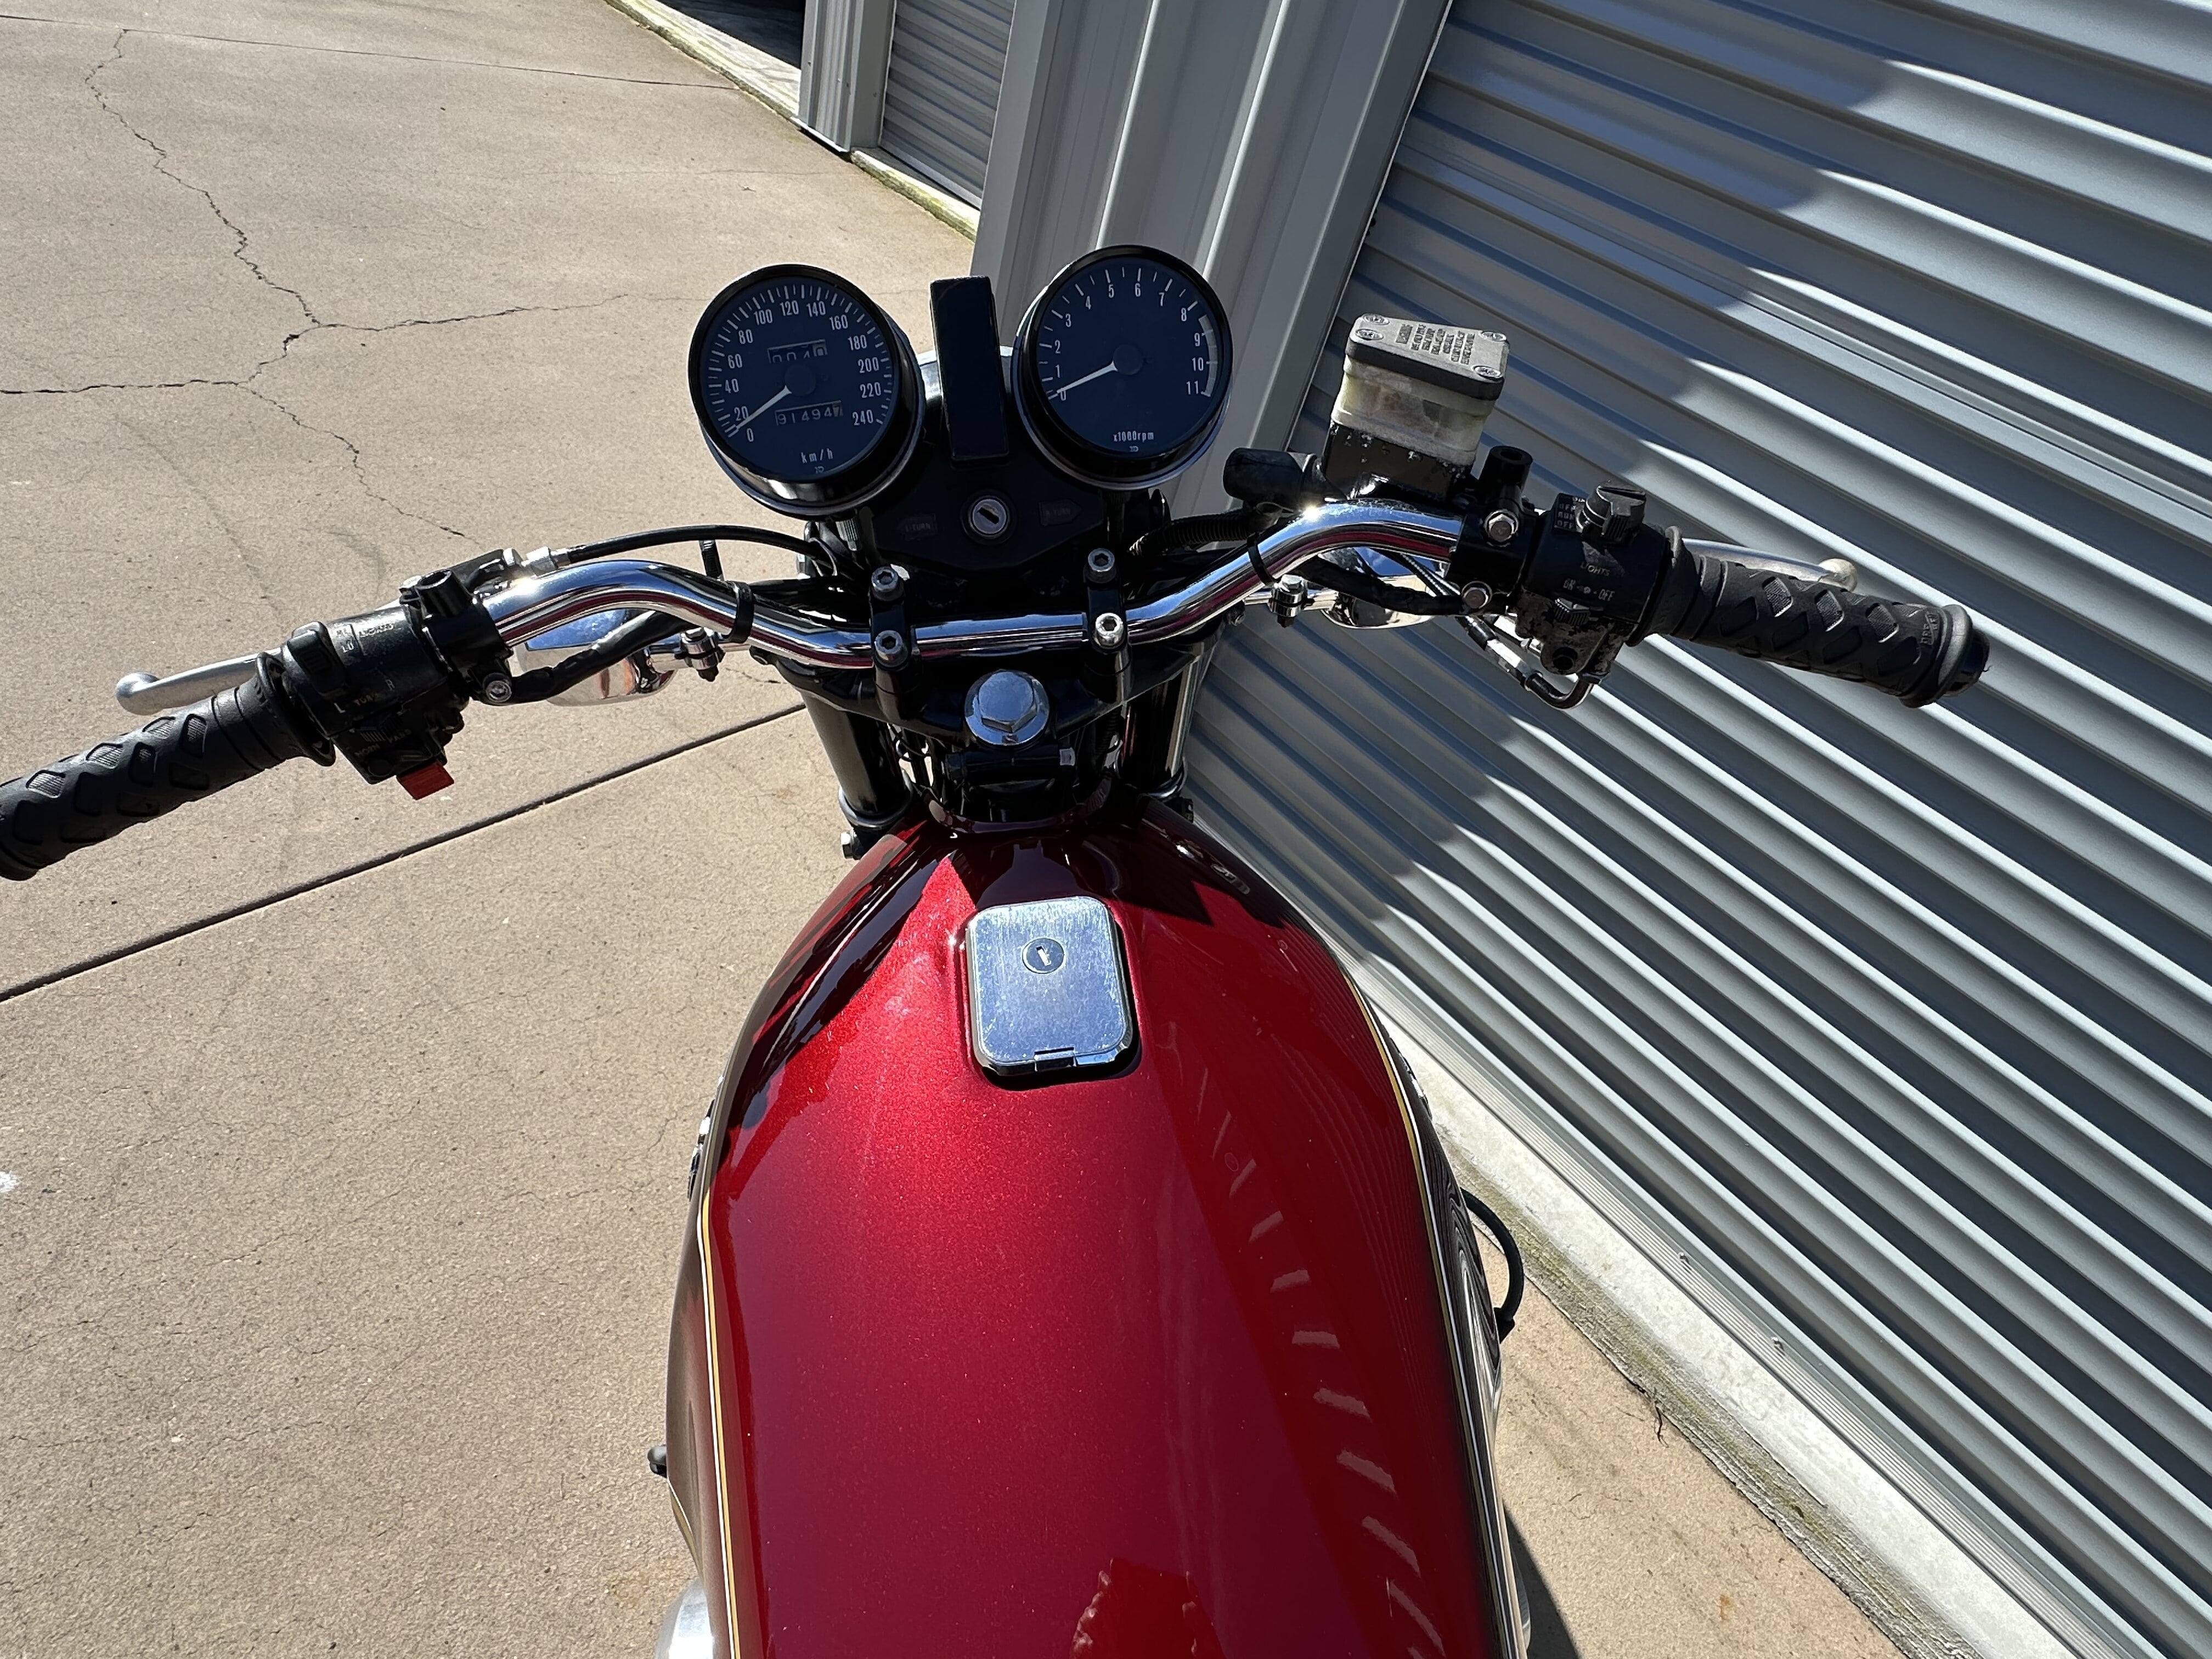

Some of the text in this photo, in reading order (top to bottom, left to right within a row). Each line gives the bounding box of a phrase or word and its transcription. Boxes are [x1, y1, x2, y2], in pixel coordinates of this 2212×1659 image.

[1108, 284, 1114, 298] 5
[1135, 283, 1141, 297] 6
[1085, 296, 1092, 310] 4
[1159, 292, 1165, 306] 7
[780, 301, 799, 316] 120
[806, 301, 826, 318] 140
[1181, 308, 1187, 322] 8
[754, 309, 772, 325] 100
[829, 315, 848, 330] 160
[1065, 314, 1071, 328] 3
[738, 329, 753, 345] 80
[848, 335, 867, 351] 180
[1194, 332, 1200, 347] 9
[1054, 340, 1061, 354] 2
[728, 354, 742, 369] 60
[858, 357, 879, 373] 200
[1192, 357, 1204, 371] 10
[1056, 365, 1060, 379] 1
[725, 379, 740, 393] 40
[860, 382, 881, 398] 220
[1186, 381, 1199, 395] 11
[734, 406, 748, 421] 20
[853, 410, 873, 426] 240
[747, 428, 754, 442] 0
[1598, 589, 1615, 602] OFF
[385, 679, 395, 691] R
[334, 702, 346, 713] L
